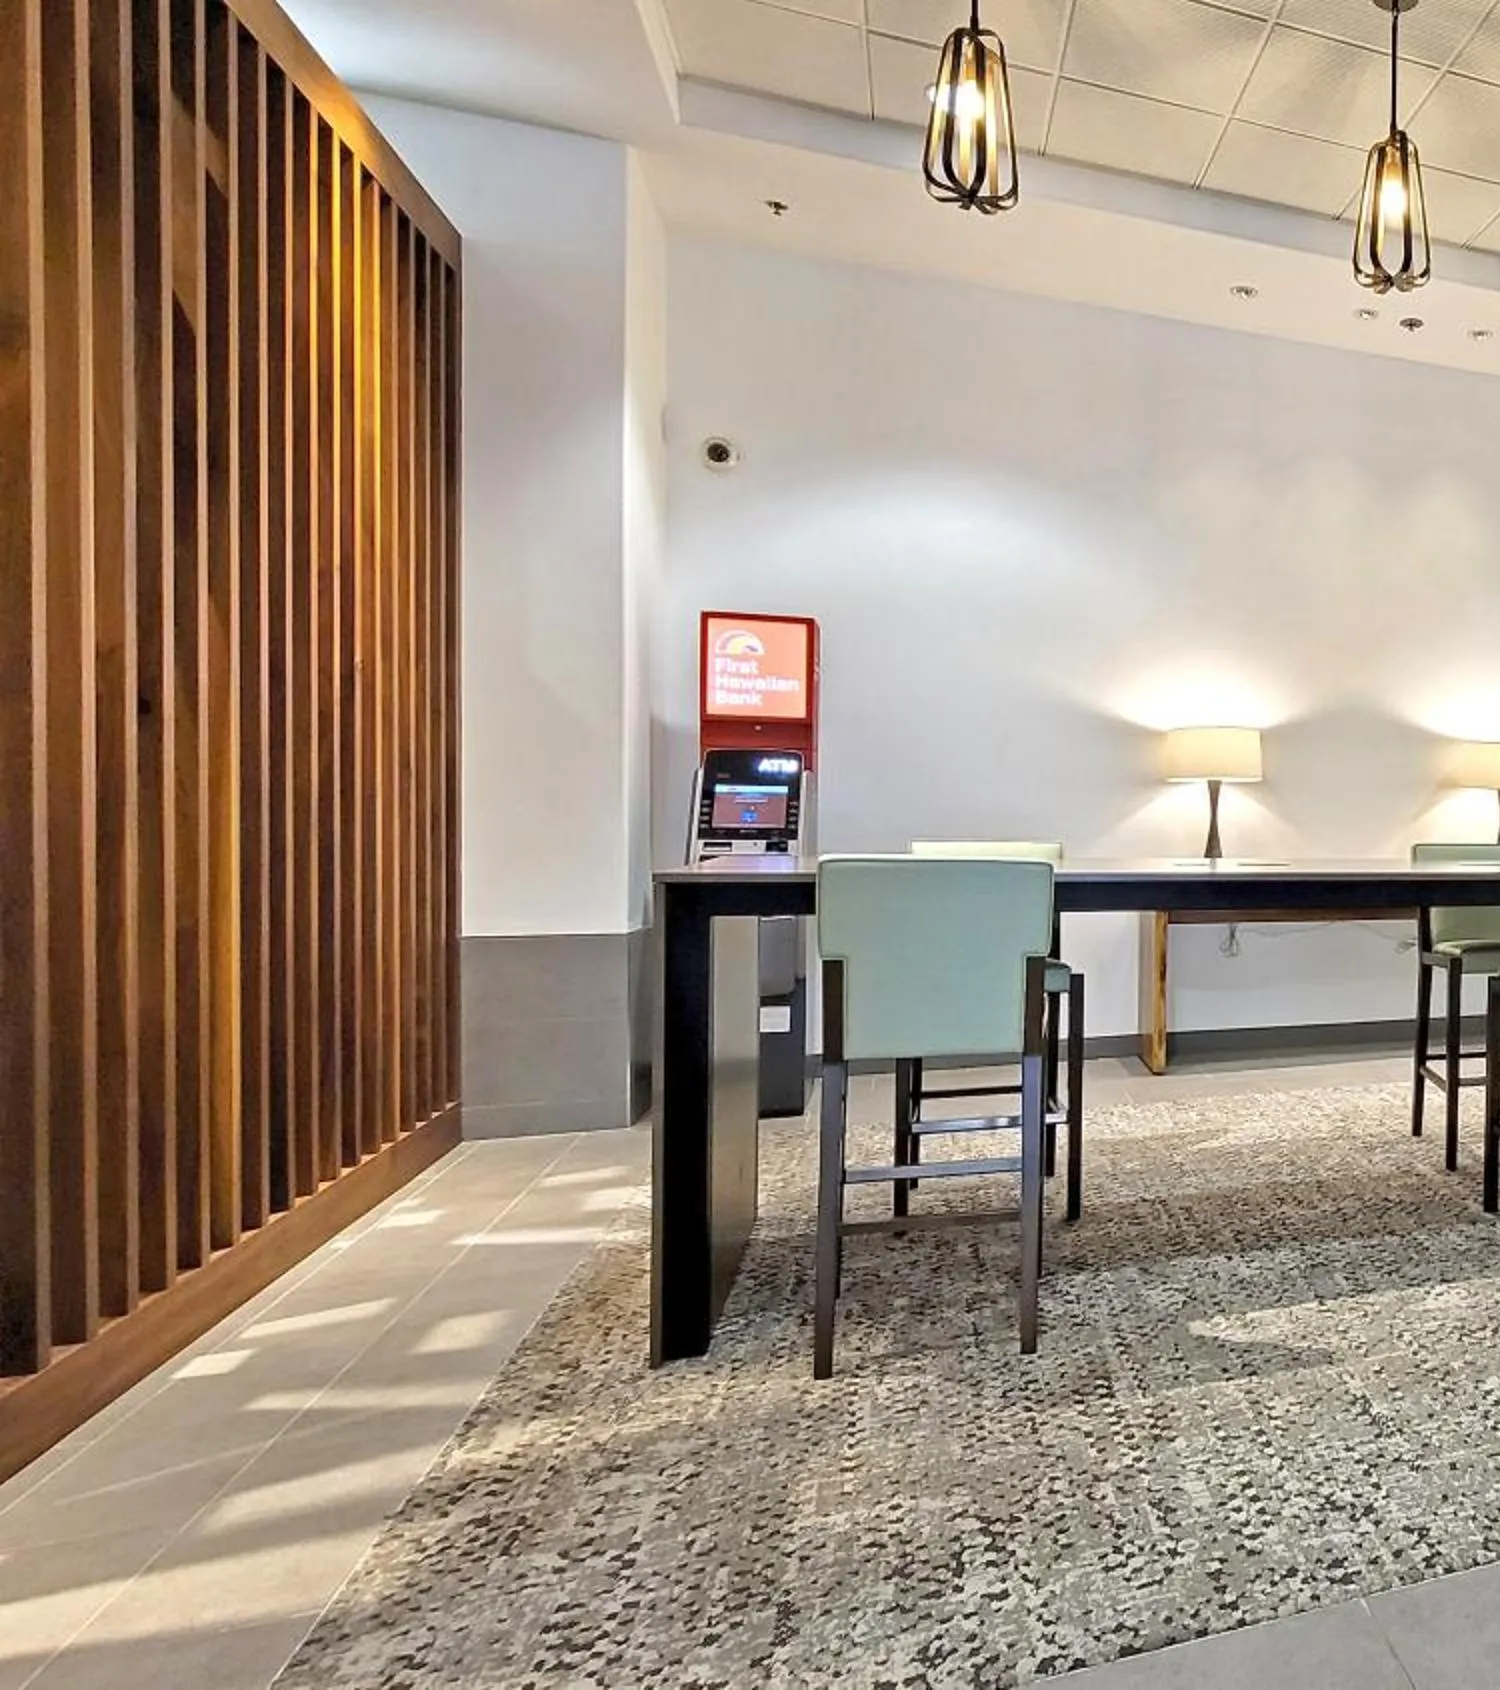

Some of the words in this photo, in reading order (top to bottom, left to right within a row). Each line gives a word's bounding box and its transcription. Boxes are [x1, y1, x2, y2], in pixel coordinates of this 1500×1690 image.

[715, 658, 759, 674] First
[715, 675, 800, 692] Hawaiian
[715, 691, 763, 705] Bank
[758, 758, 799, 773] ATM
